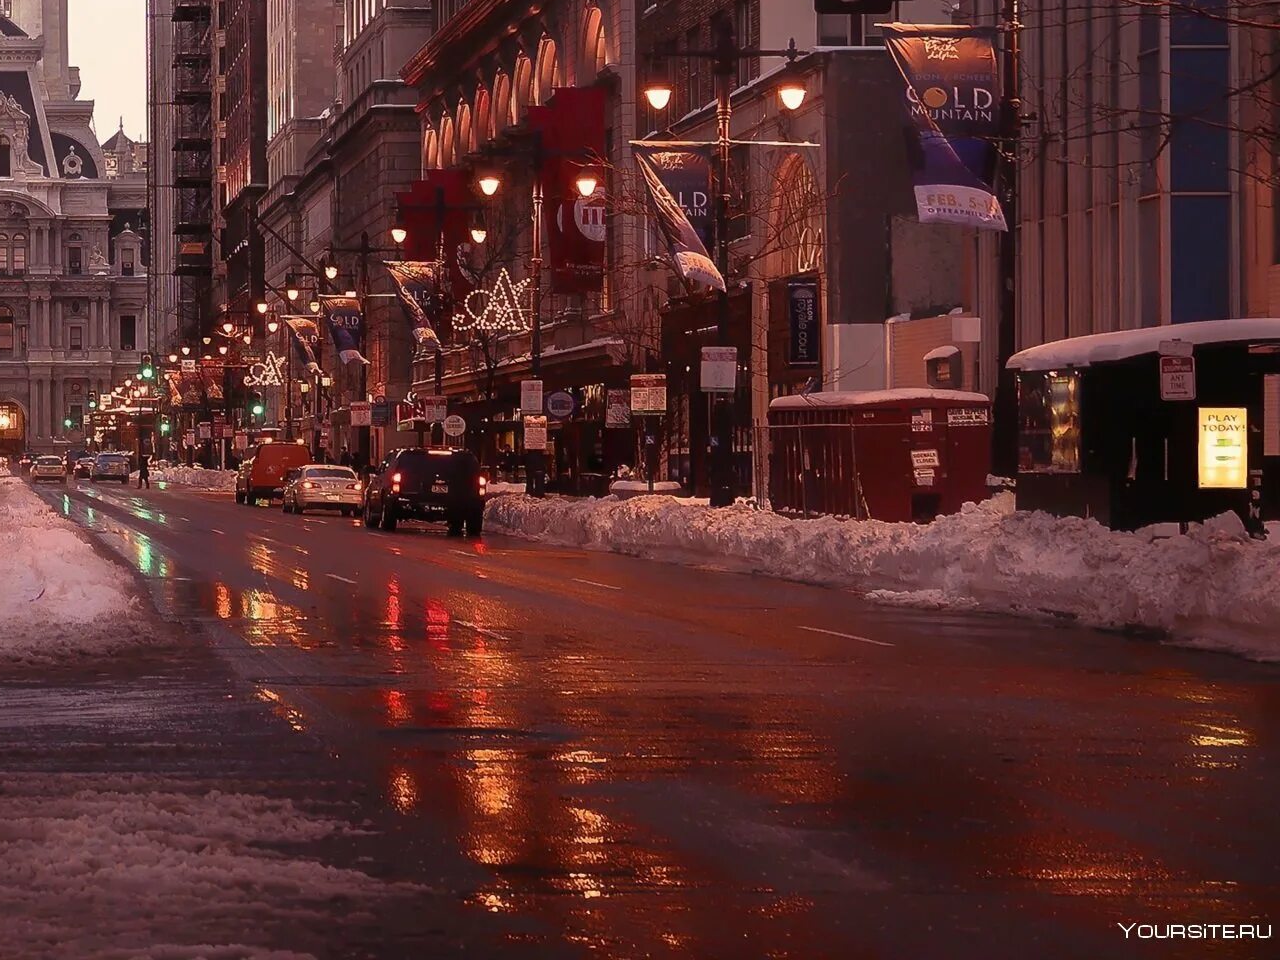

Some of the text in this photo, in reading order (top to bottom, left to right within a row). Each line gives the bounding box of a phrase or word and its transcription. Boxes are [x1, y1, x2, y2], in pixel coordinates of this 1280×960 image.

[798, 331, 808, 359] court
[1207, 414, 1239, 422] PLAY
[1202, 424, 1246, 432] TODAY!
